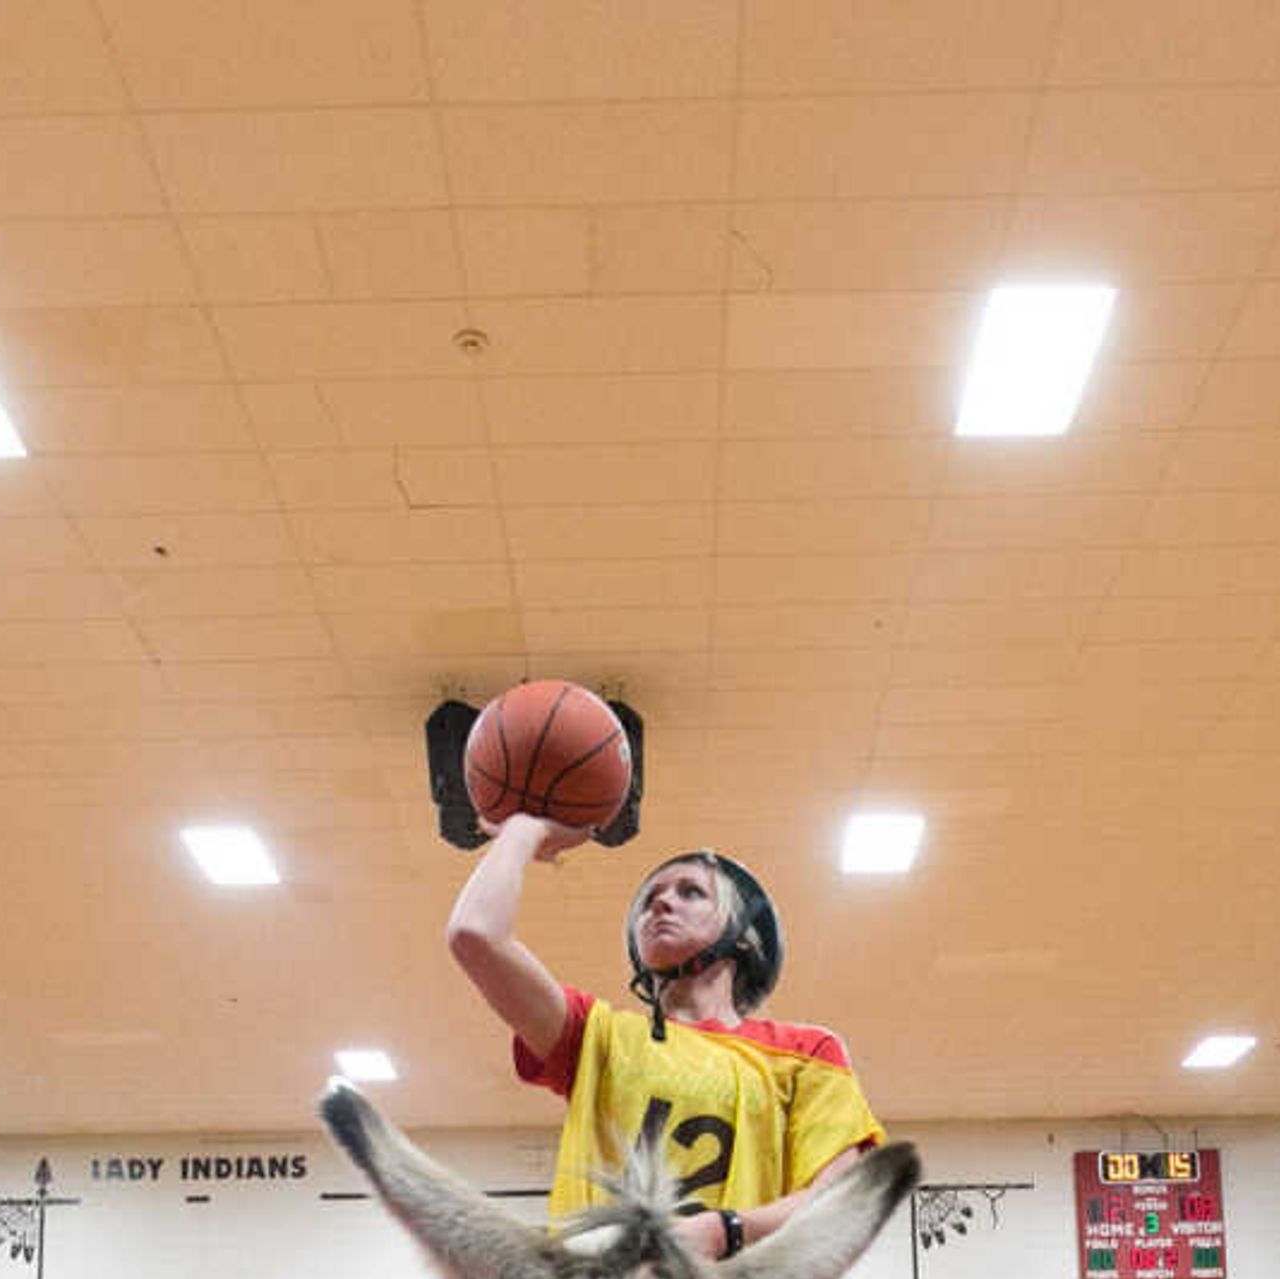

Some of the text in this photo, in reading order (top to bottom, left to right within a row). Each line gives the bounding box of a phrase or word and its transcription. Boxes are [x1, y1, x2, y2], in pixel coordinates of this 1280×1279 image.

[90, 1155, 308, 1180] LADY INDIANS
[1086, 1223, 1135, 1237] HOME
